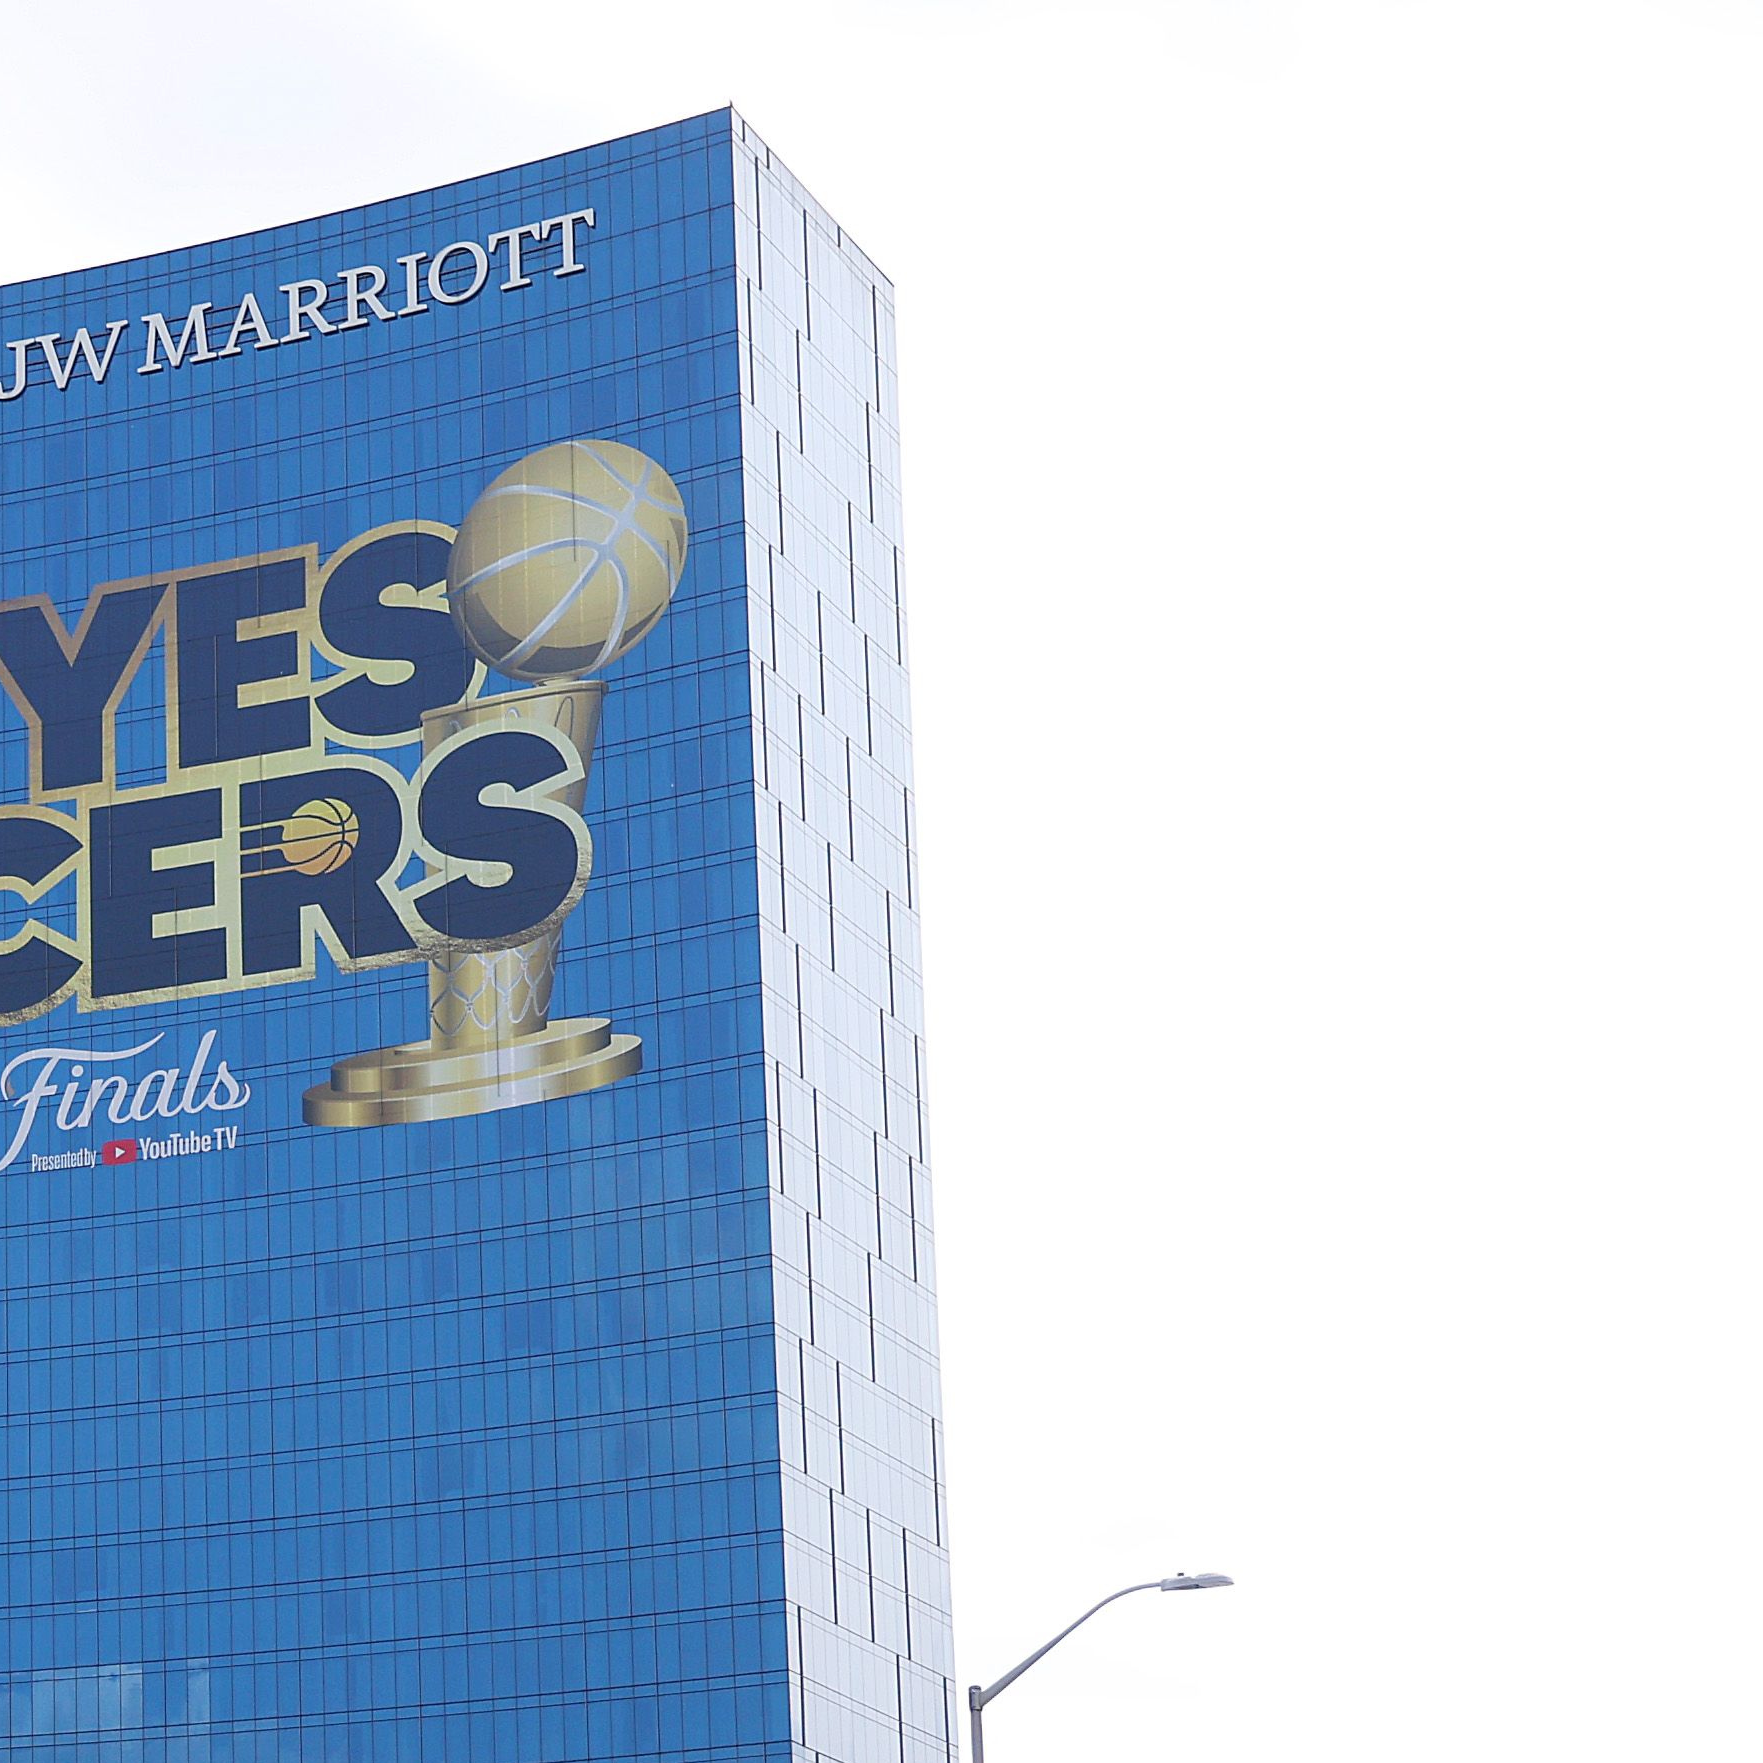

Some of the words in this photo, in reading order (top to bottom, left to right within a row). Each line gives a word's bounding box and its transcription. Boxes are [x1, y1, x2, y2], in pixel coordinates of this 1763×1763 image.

[136, 209, 595, 376] MARRIOTT
[31, 1150, 83, 1173] Presented
[82, 1148, 97, 1170] by
[139, 1132, 212, 1161] YouTube
[213, 1126, 238, 1150] TV
